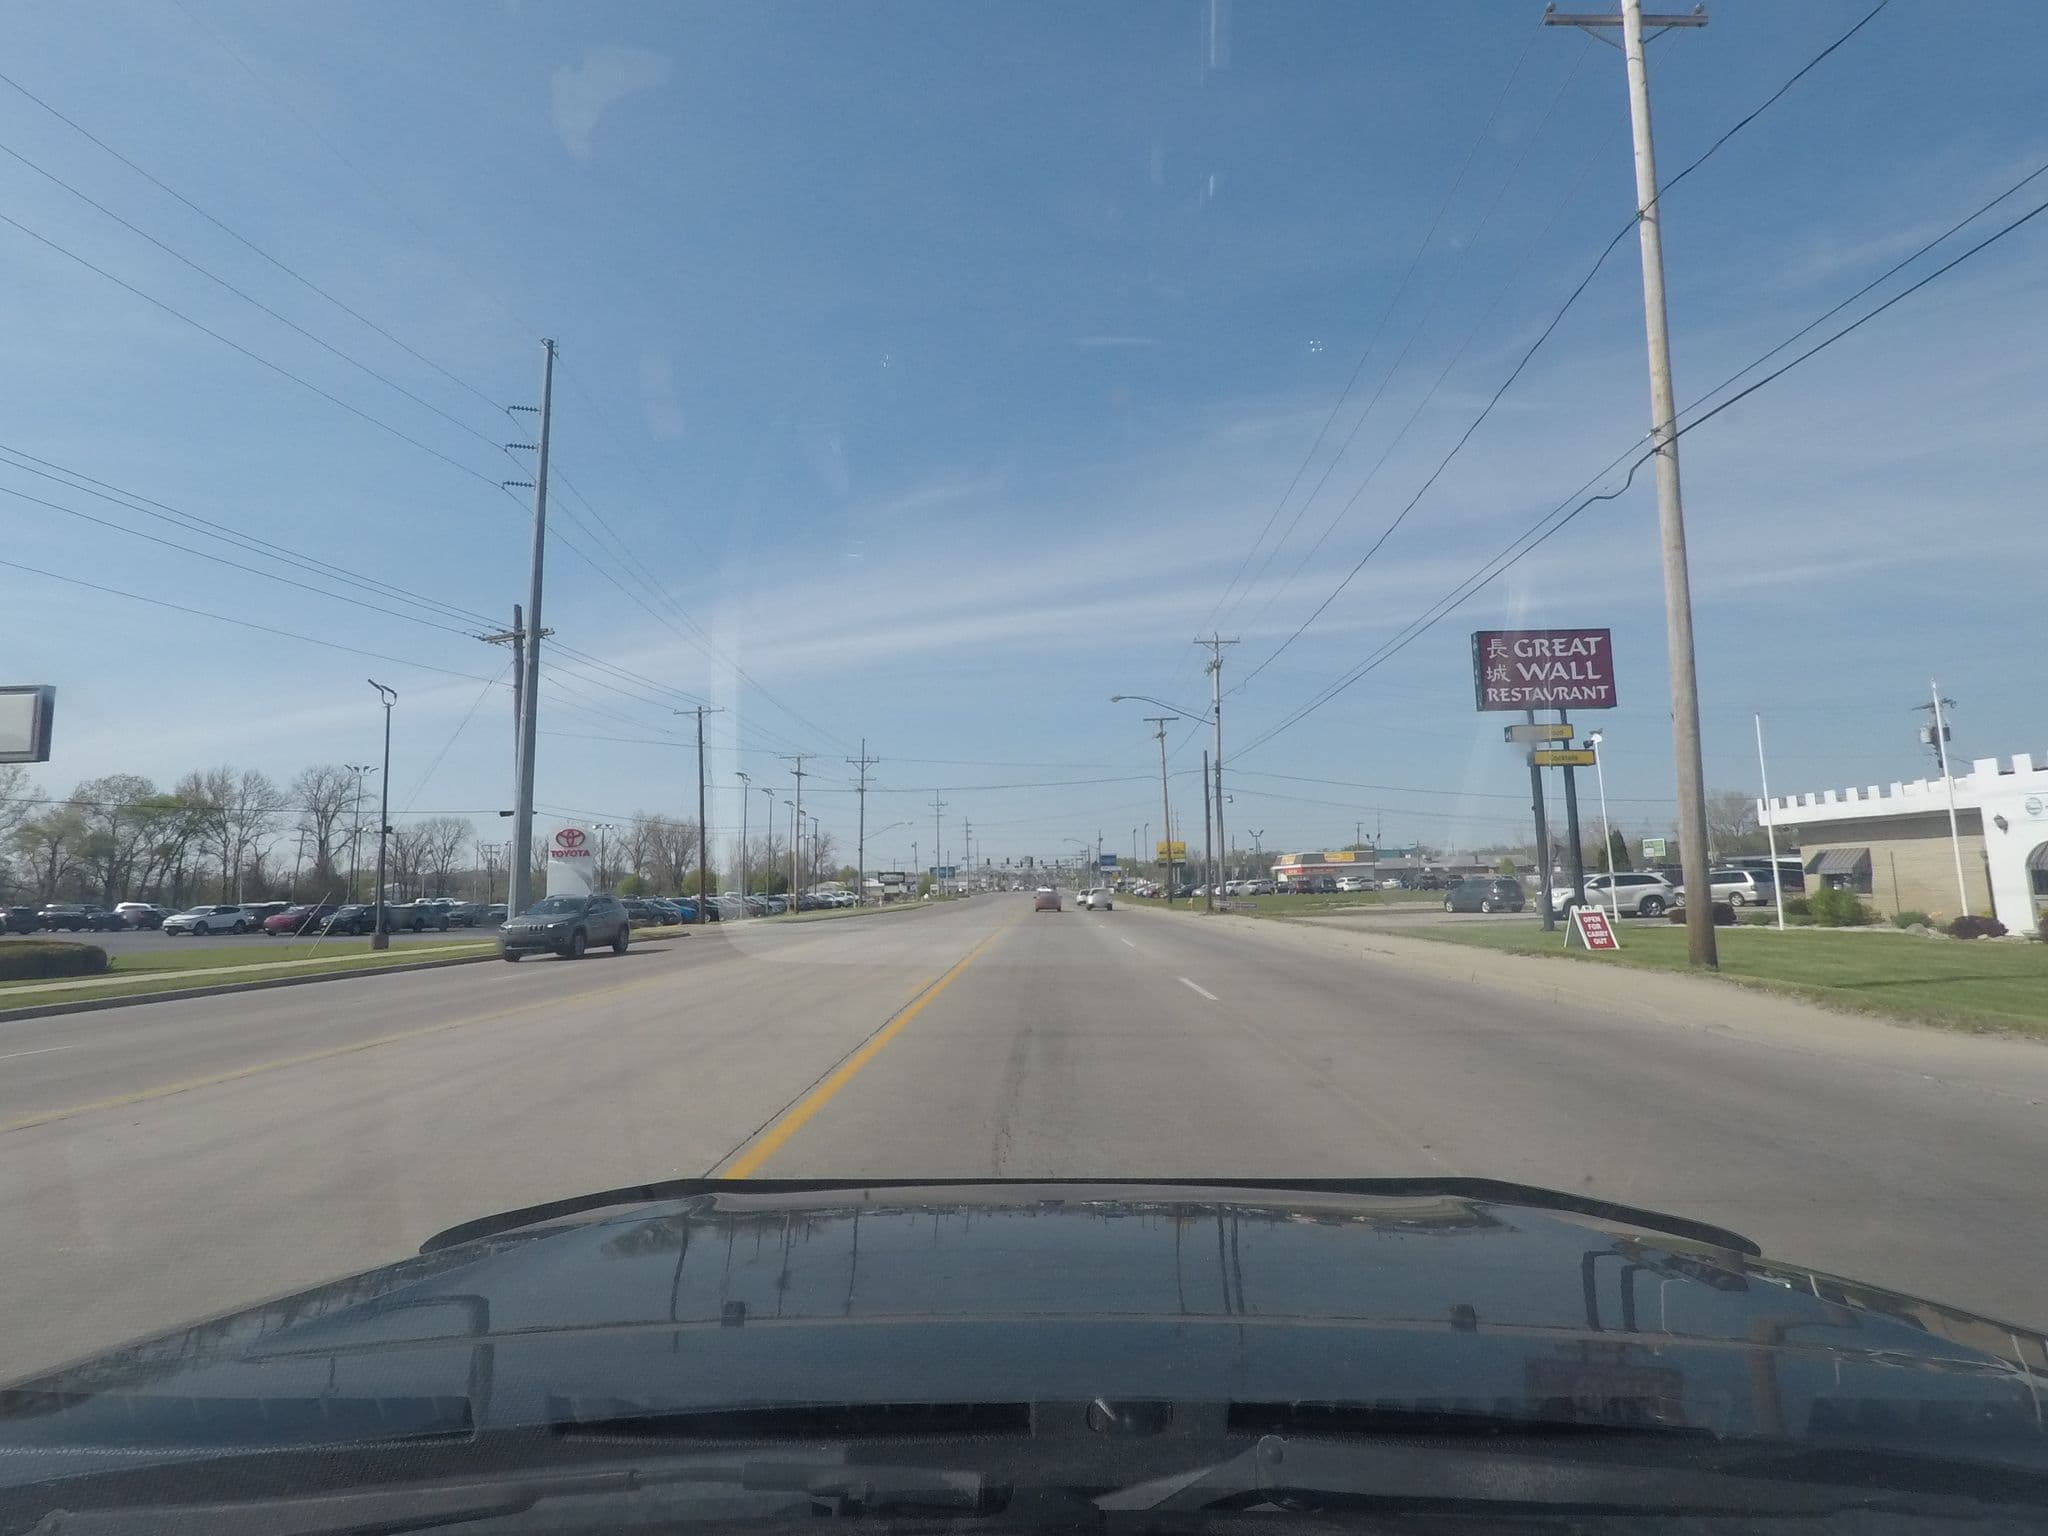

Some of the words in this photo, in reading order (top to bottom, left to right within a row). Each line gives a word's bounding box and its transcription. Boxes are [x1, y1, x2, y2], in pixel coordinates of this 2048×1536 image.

[1513, 636, 1603, 658] GREAT
[1516, 660, 1602, 681] WALL
[1486, 685, 1609, 702] RESTAURANT
[550, 849, 591, 858] TOYOTA
